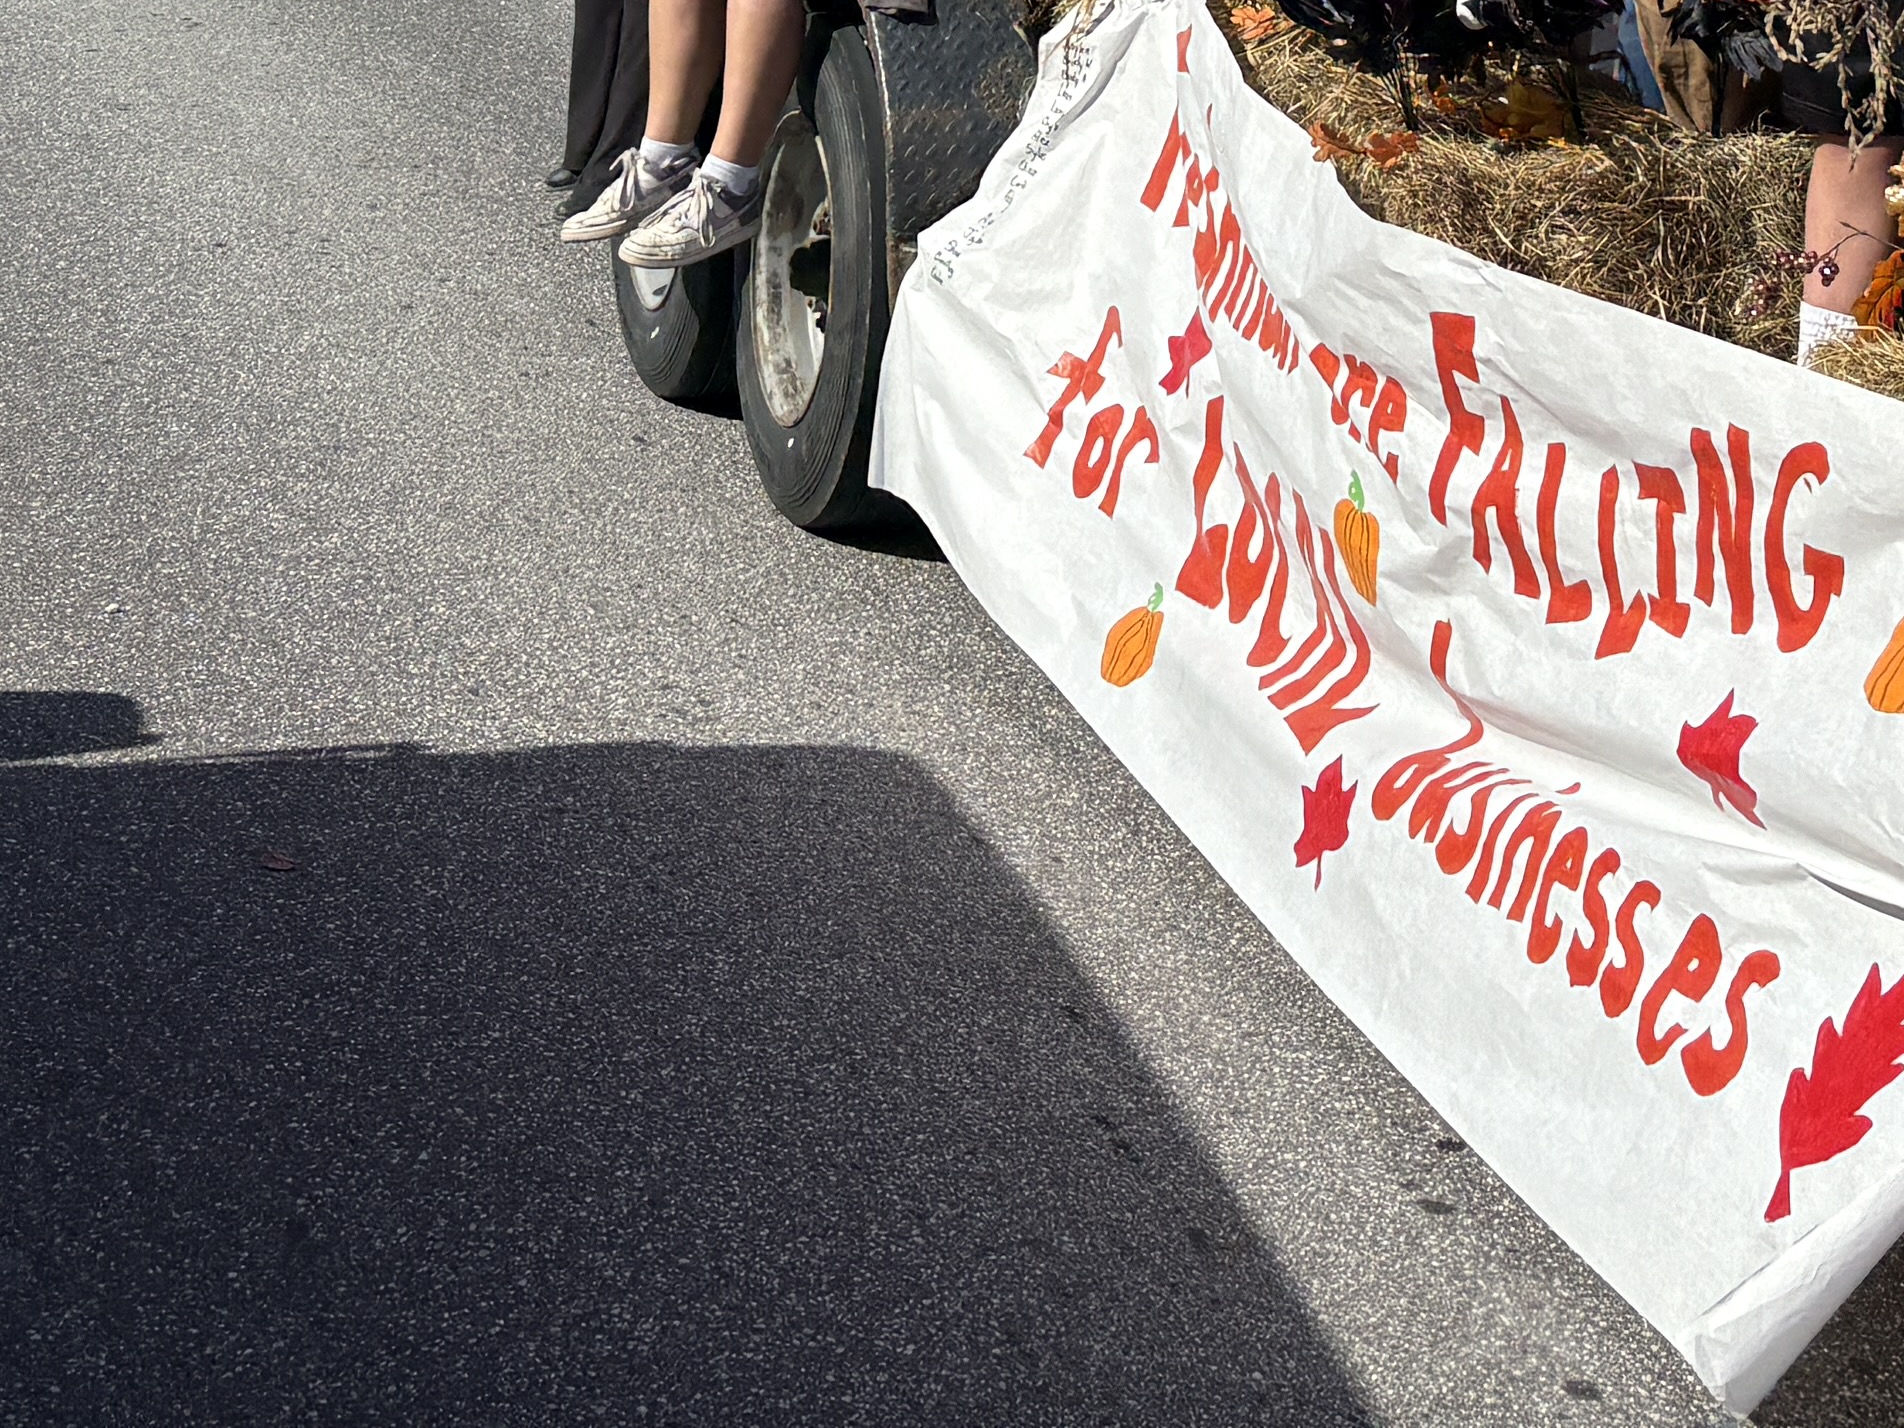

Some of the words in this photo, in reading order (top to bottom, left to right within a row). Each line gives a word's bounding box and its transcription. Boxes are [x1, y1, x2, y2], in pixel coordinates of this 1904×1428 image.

[1023, 305, 1160, 519] for
[1428, 311, 1845, 660] FALLING
[1371, 617, 1781, 1097] businesses
